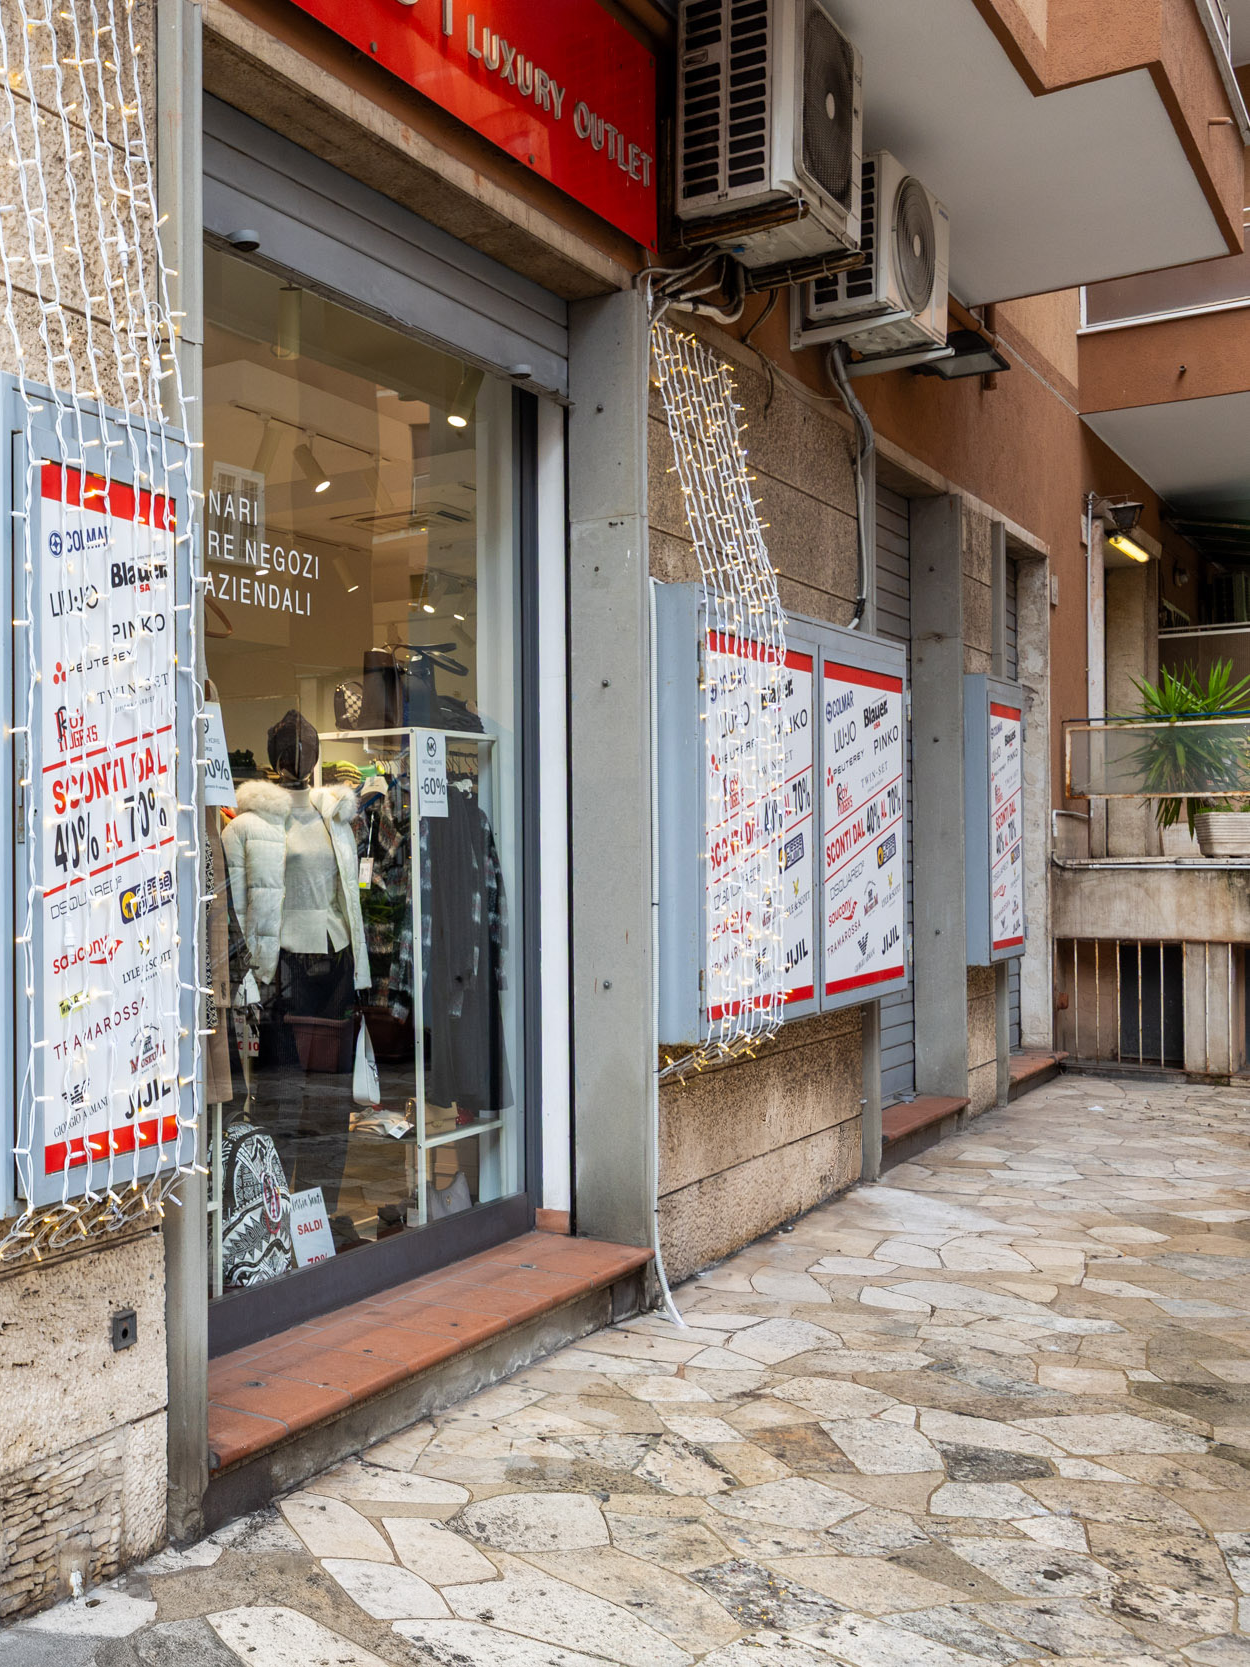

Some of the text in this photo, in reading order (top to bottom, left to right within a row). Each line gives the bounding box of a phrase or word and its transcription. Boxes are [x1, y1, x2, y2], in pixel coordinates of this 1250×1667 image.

[467, 14, 652, 188] LUXURY OUTLET
[209, 489, 258, 526] NARI
[208, 530, 319, 580] RE NEGOZI
[204, 571, 311, 616] AZIENDALI
[833, 690, 854, 718] COLMAR
[863, 699, 888, 728] Blauer
[873, 725, 899, 755] PINKO
[833, 748, 865, 776] PEUTEREY
[421, 777, 446, 796] -60%
[792, 775, 811, 816] 70%
[866, 783, 901, 836] 40% AL 70%
[54, 812, 100, 873] 40%
[826, 817, 866, 868] SCONTI DAL
[882, 925, 900, 955] JIJIL
[297, 1218, 323, 1236] SALDI
